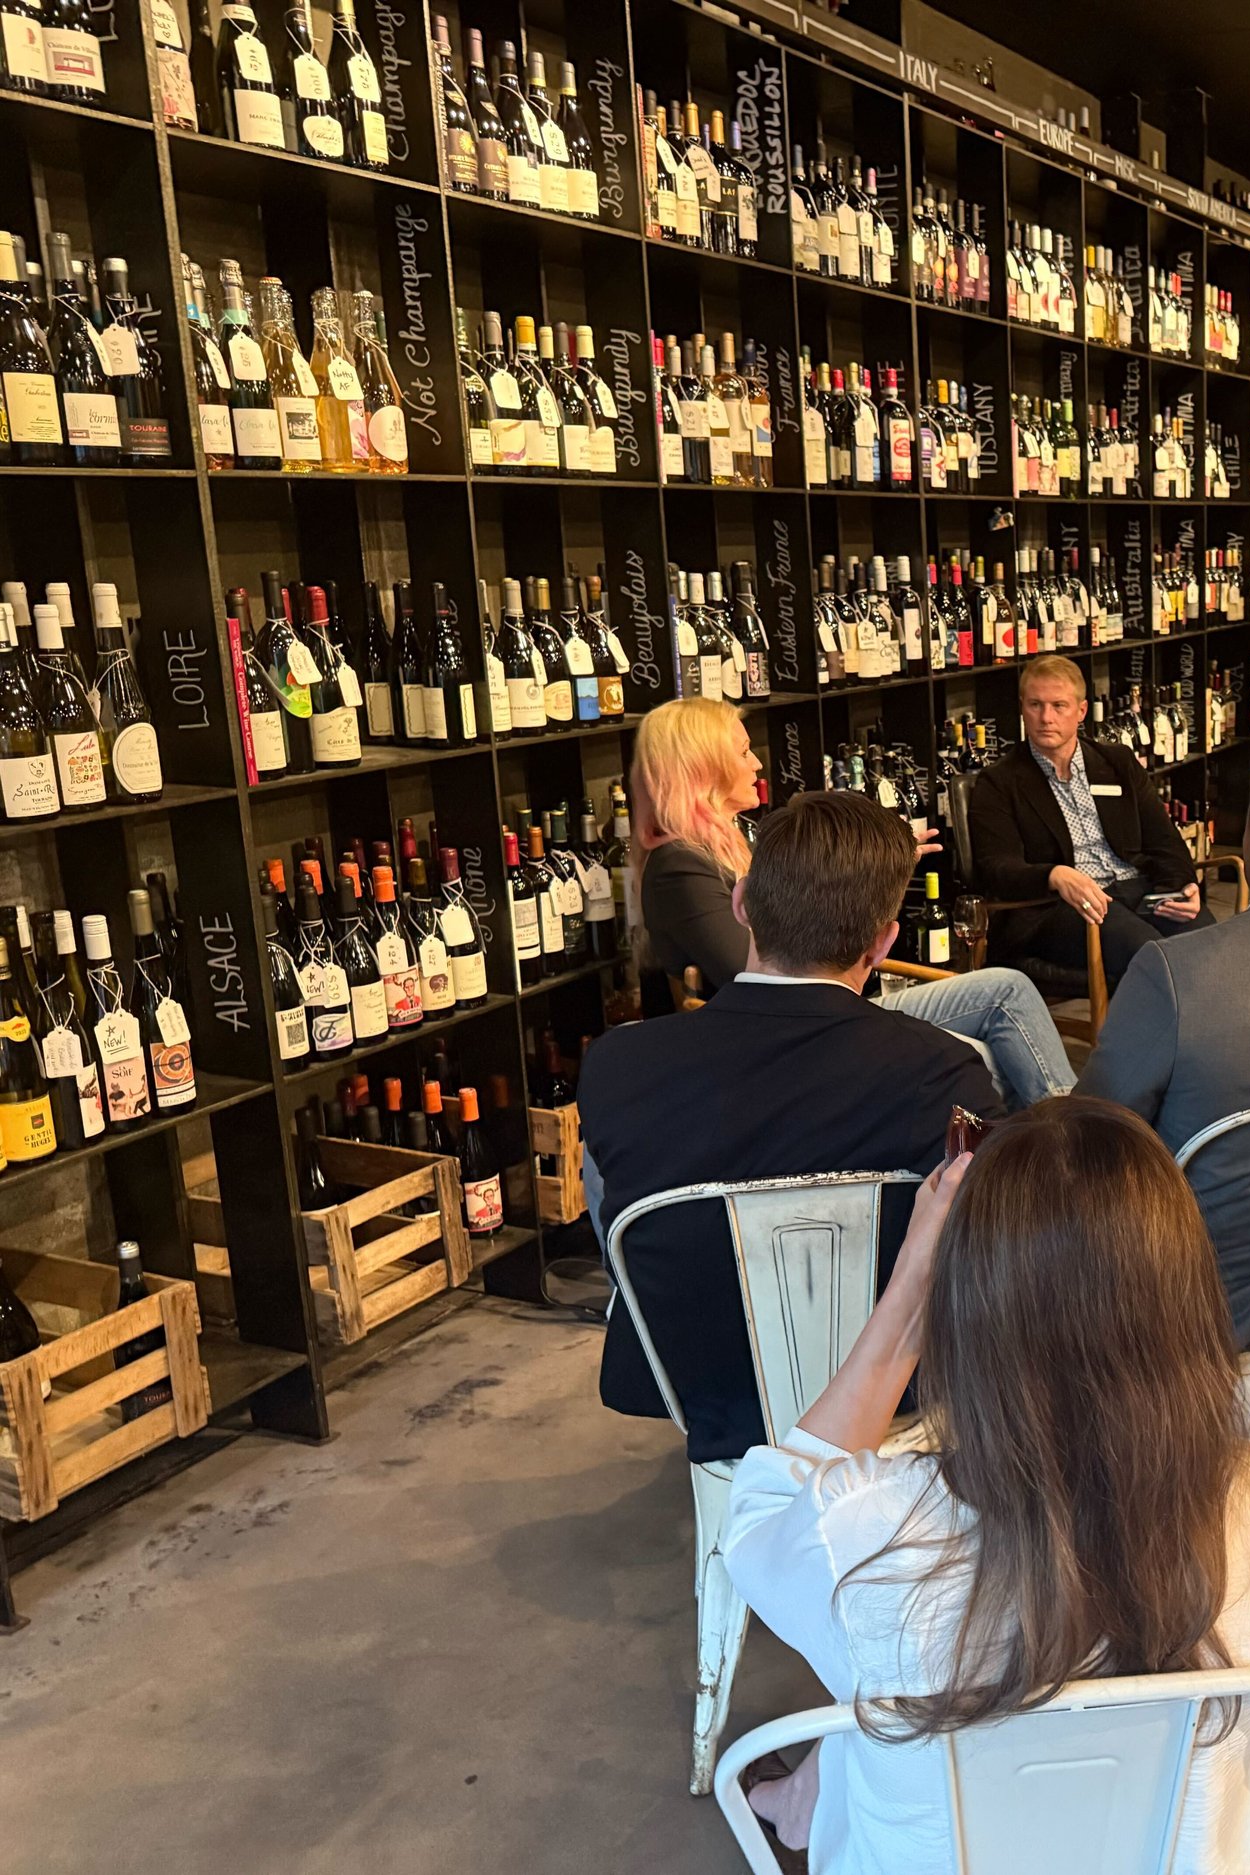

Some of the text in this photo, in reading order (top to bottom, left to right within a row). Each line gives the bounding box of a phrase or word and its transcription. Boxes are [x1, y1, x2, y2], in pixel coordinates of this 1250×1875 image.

[899, 51, 940, 93] ITALY
[588, 56, 627, 218] Burgundy
[759, 58, 788, 214] ROUSSILLON
[1039, 118, 1076, 156] EUROPE
[405, 376, 442, 446] Not
[973, 383, 999, 474] TUSCANY
[1224, 434, 1241, 490] CHILE
[619, 550, 665, 689] Beaujolais
[766, 519, 799, 682] Eastern France
[1122, 520, 1145, 633] Australia
[163, 629, 210, 730] LOIRE
[1180, 642, 1195, 678] WORLD
[237, 671, 248, 709] Complete
[245, 731, 253, 760] Course
[779, 721, 799, 794] France
[199, 911, 252, 1033] ALSACE
[103, 1030, 127, 1049] NEW!
